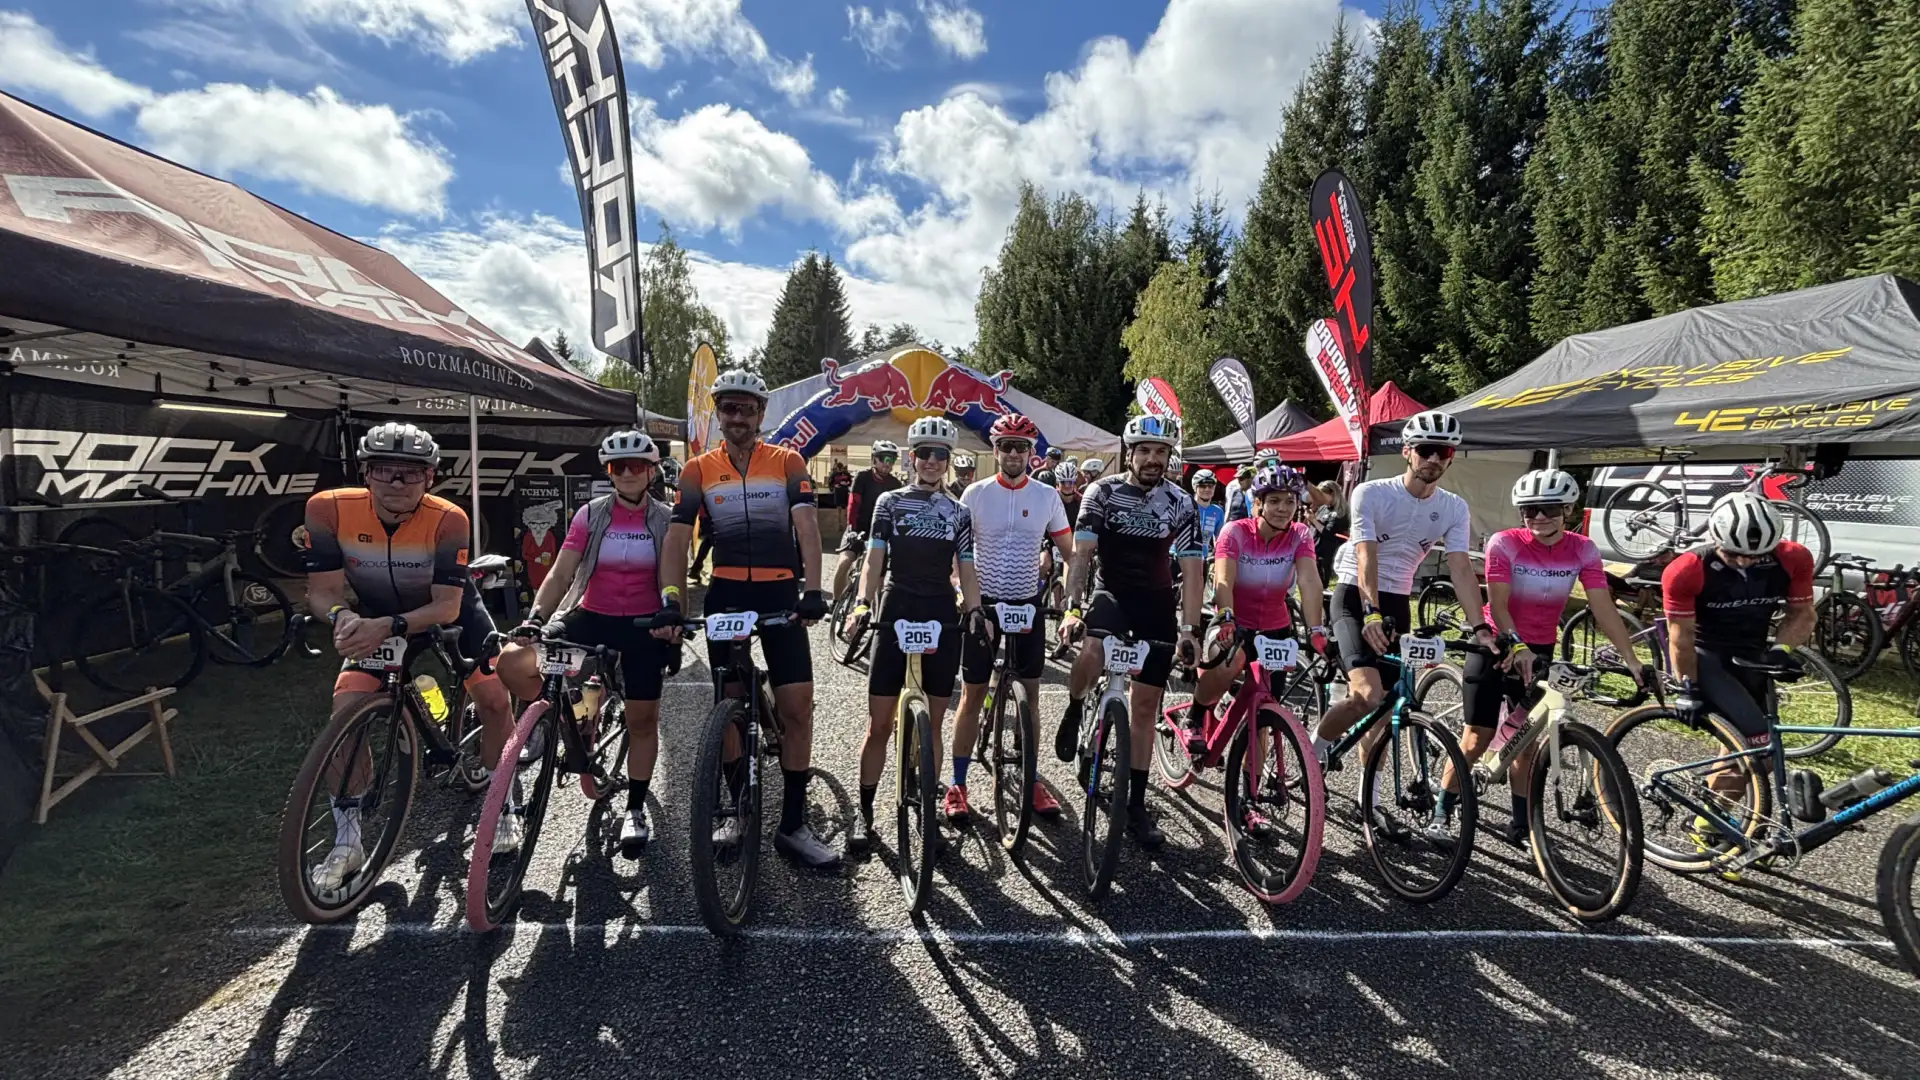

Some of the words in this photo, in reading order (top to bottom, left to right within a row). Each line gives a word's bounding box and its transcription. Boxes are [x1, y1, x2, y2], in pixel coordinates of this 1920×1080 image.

[399, 346, 535, 391] ROCKMACHINE.US
[1757, 398, 1913, 418] EXCLUSIVE
[1748, 414, 1876, 431] BICYCLES
[0, 428, 278, 474] ROCK
[36, 472, 320, 499] MACHINE
[1805, 493, 1916, 503] EXCLUSIVE
[1805, 502, 1897, 513] BICYCLES
[714, 619, 745, 632] 210
[1004, 612, 1028, 625] 204
[904, 631, 932, 645] 205
[368, 649, 394, 662] 20
[546, 650, 573, 665] 211
[1111, 649, 1138, 664] 202
[1264, 647, 1290, 662] 207
[1408, 646, 1436, 660] 219
